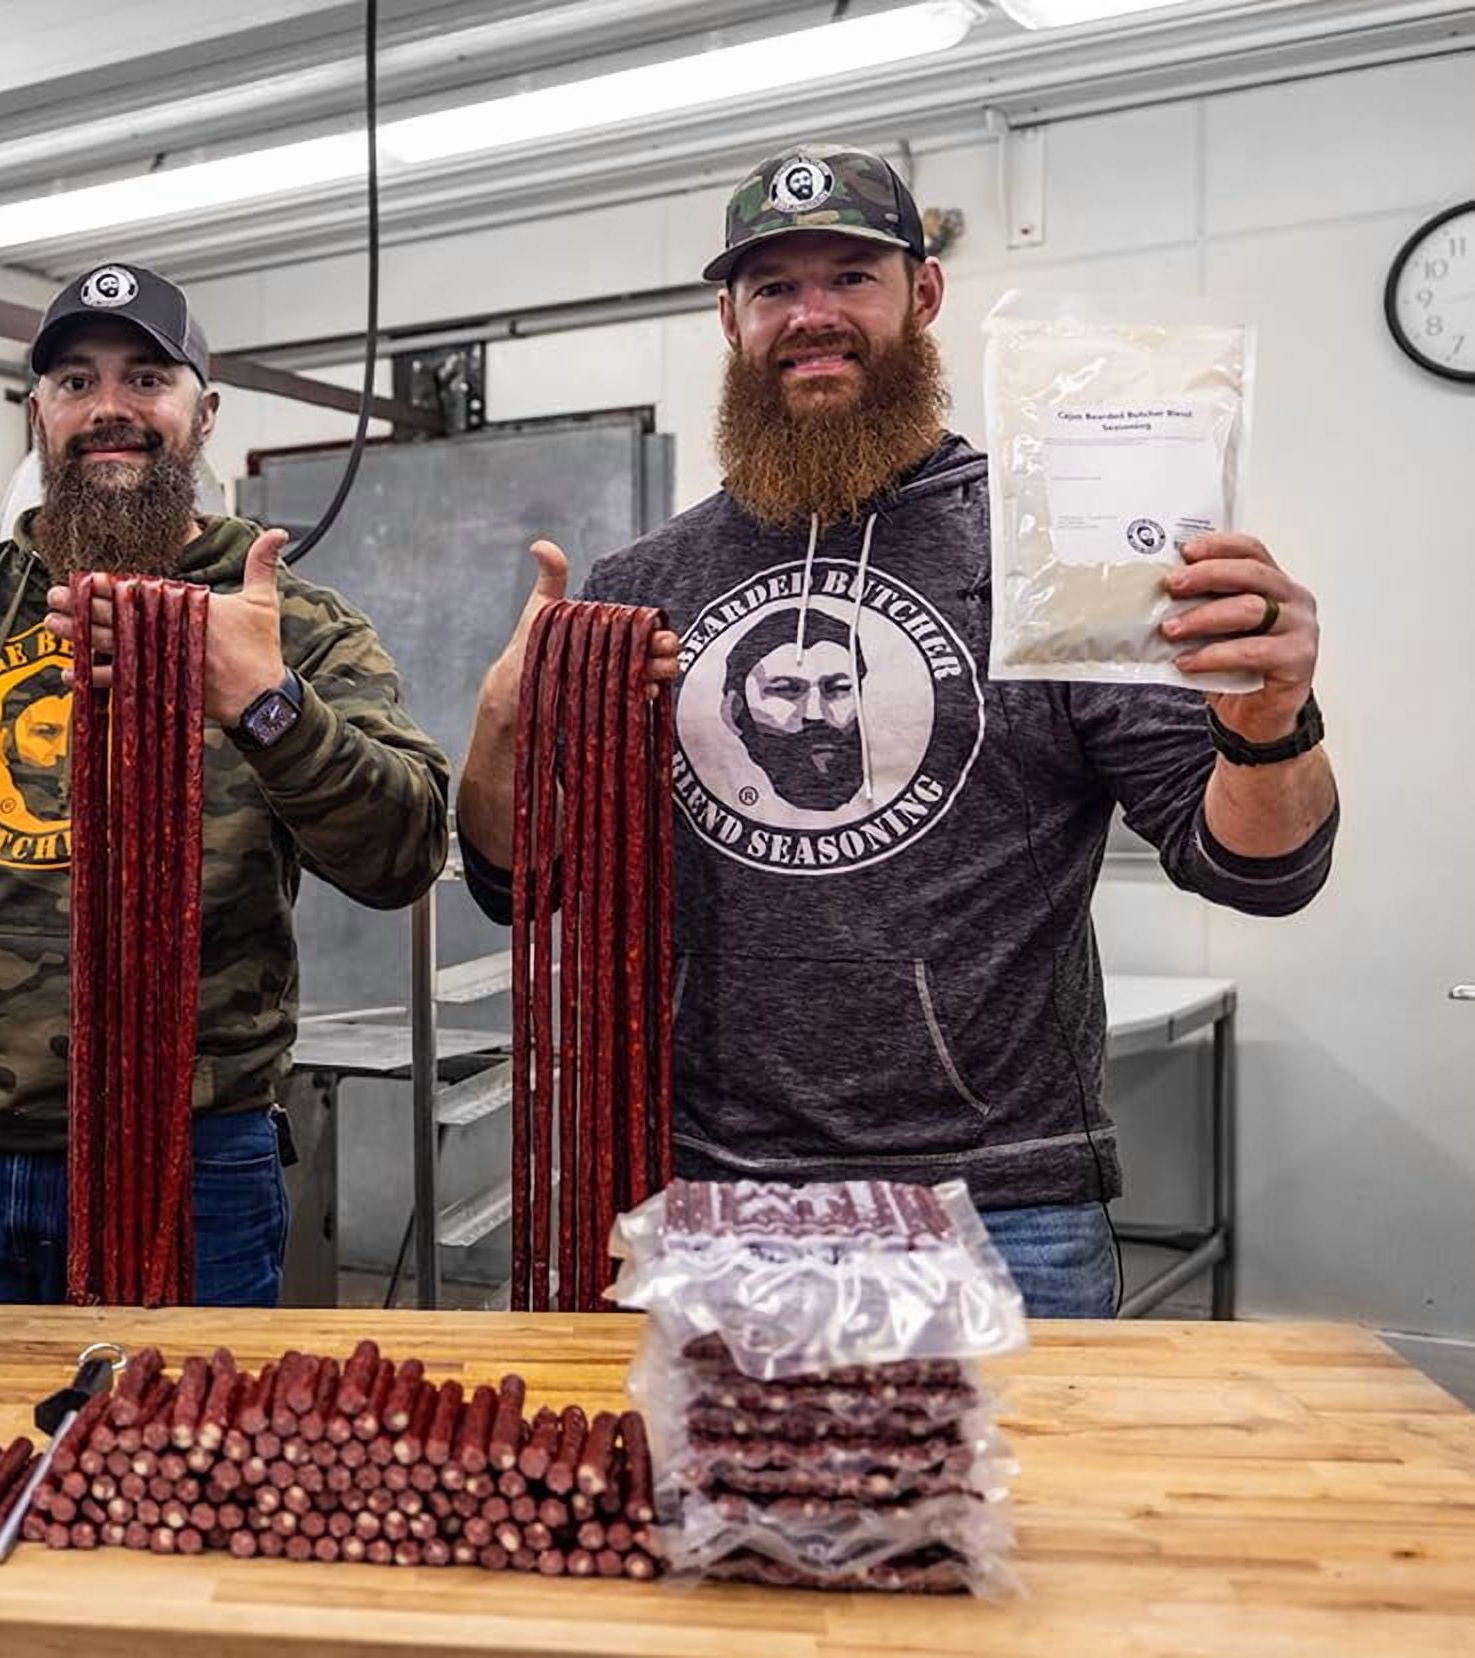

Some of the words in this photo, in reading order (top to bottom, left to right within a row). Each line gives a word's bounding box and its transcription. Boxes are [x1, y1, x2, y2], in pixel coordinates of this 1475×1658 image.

[1449, 236, 1466, 257] 11
[1425, 257, 1449, 281] 10
[1416, 288, 1433, 309] 9
[1425, 314, 1444, 336] 8
[1451, 334, 1465, 355] 7
[1085, 412, 1125, 421] Bearded
[1127, 410, 1164, 420] Butcher
[677, 571, 814, 674] BEARDED
[821, 570, 962, 682] BUTCHER
[671, 750, 743, 845] BLEND
[746, 774, 944, 866] SEASONING
